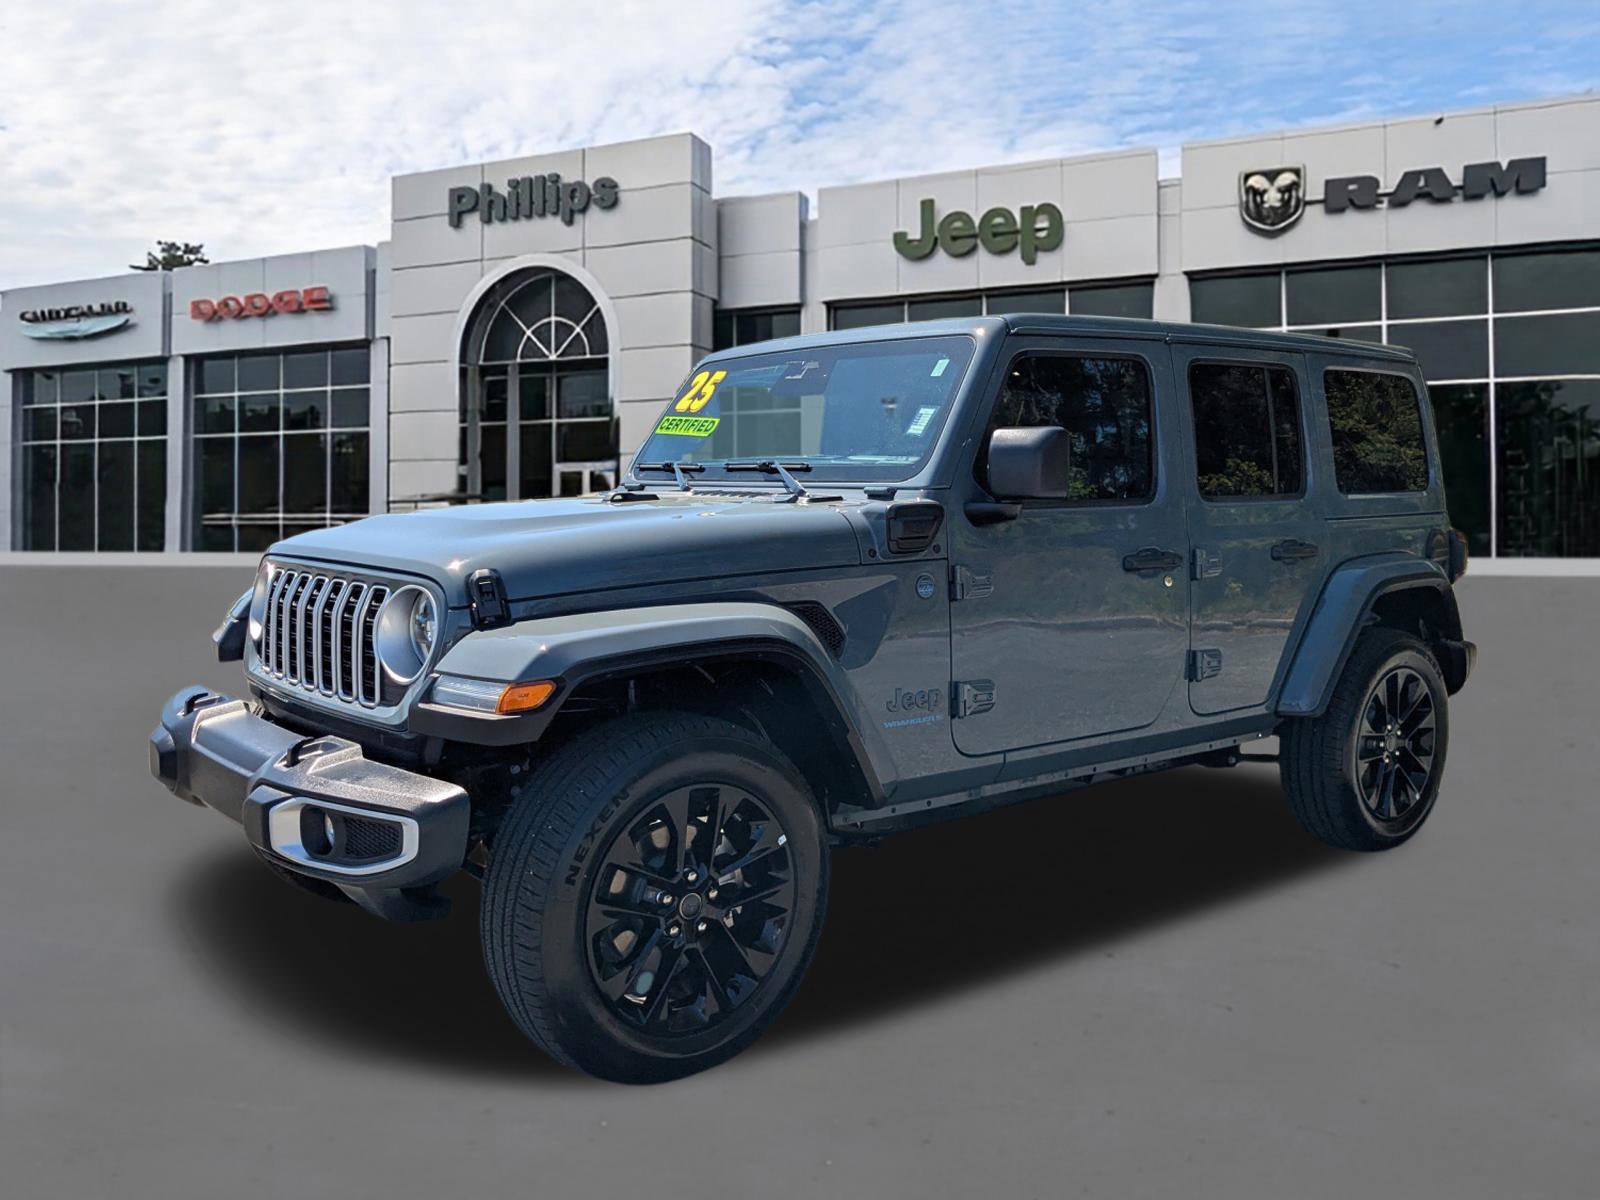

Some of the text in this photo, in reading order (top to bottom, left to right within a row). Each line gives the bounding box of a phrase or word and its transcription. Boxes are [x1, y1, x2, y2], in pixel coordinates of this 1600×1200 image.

[449, 173, 619, 228] Phillips
[1324, 156, 1547, 215] RAM
[893, 198, 1064, 266] Jeep
[190, 286, 334, 322] DODGE
[674, 370, 728, 413] 25
[659, 417, 717, 434] CERTIFIED
[886, 688, 942, 712] Jeep
[564, 787, 630, 886] NEXEN
